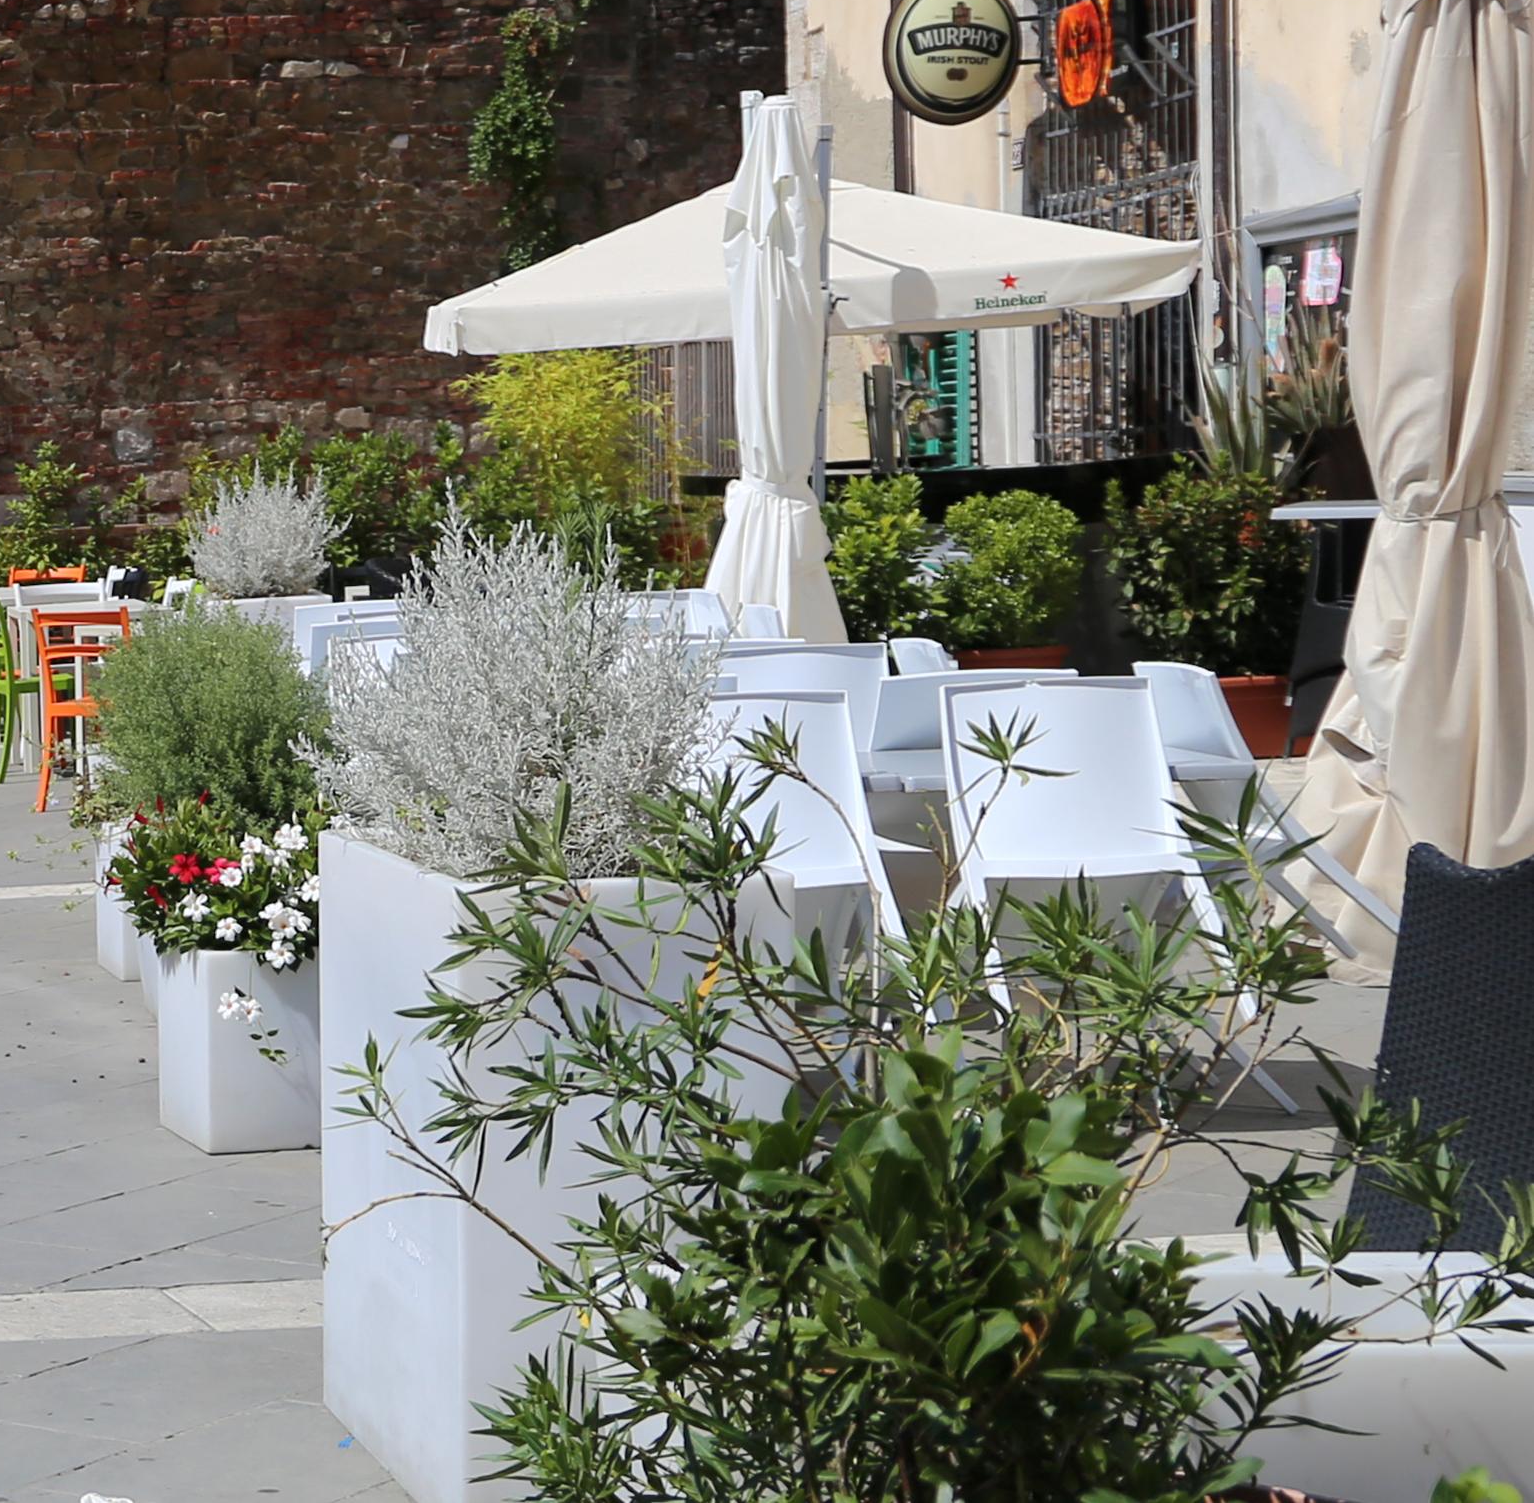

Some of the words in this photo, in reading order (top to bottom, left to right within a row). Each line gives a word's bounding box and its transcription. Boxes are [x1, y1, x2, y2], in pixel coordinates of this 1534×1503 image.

[927, 56, 954, 65] IRISH
[956, 56, 990, 66] STOUT
[975, 294, 1047, 310] Heineken
